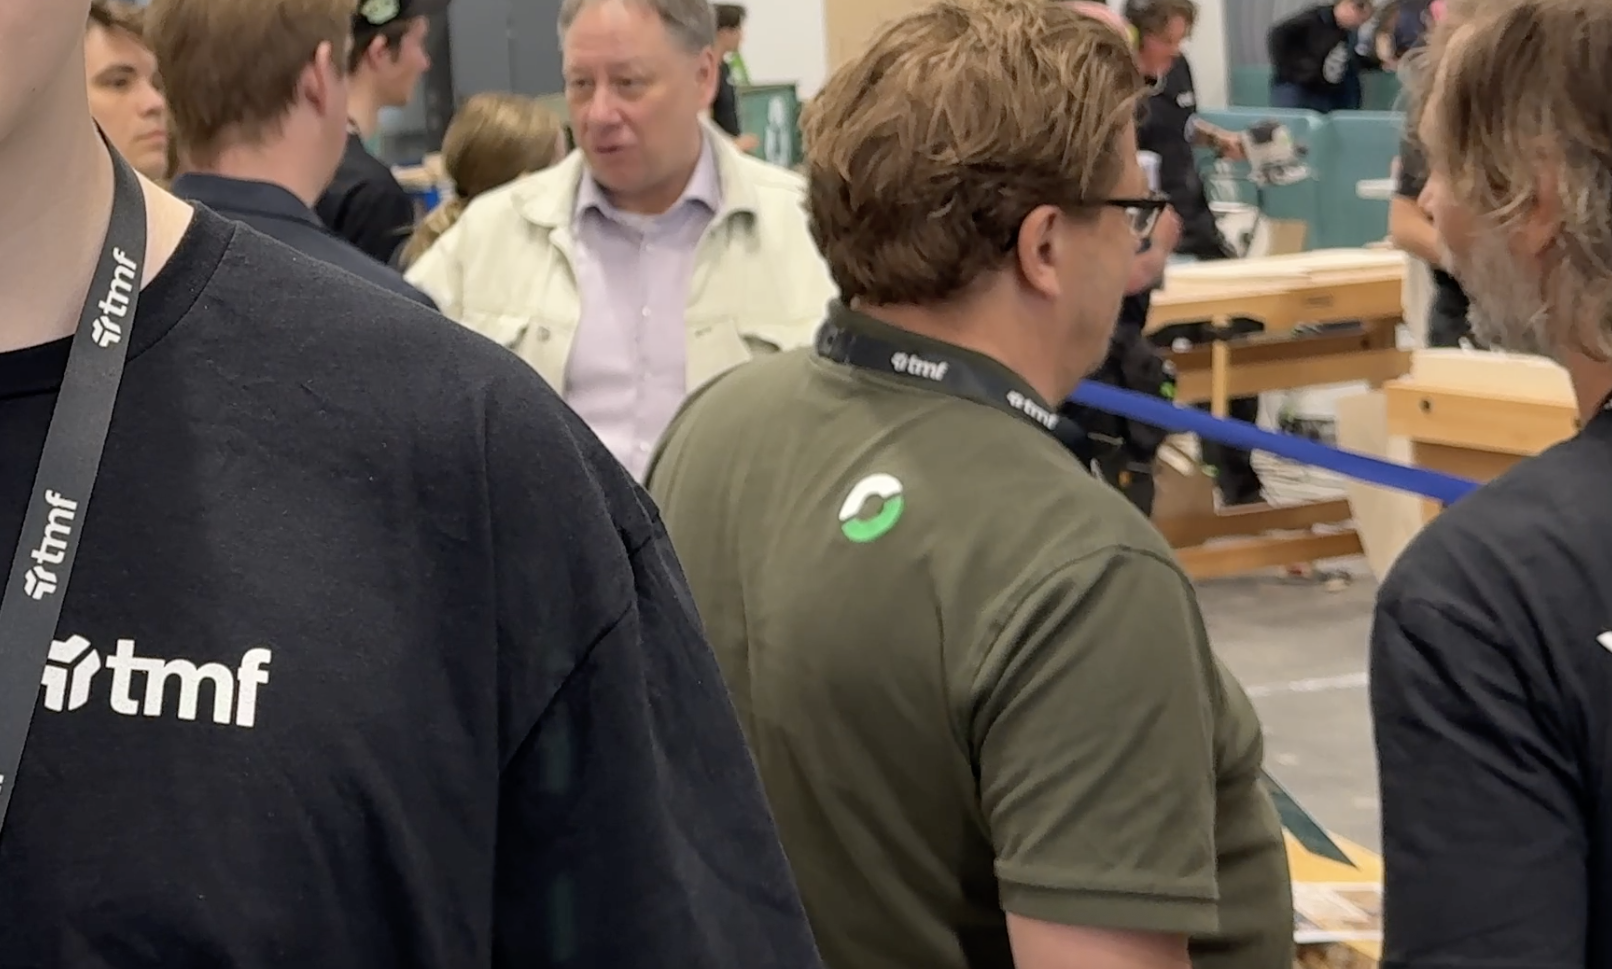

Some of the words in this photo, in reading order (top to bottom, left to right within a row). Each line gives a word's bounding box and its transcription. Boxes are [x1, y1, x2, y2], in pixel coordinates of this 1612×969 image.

[99, 247, 137, 317] tmf
[905, 353, 950, 382] tmf
[30, 489, 78, 564] tmf
[105, 638, 273, 728] tmf
